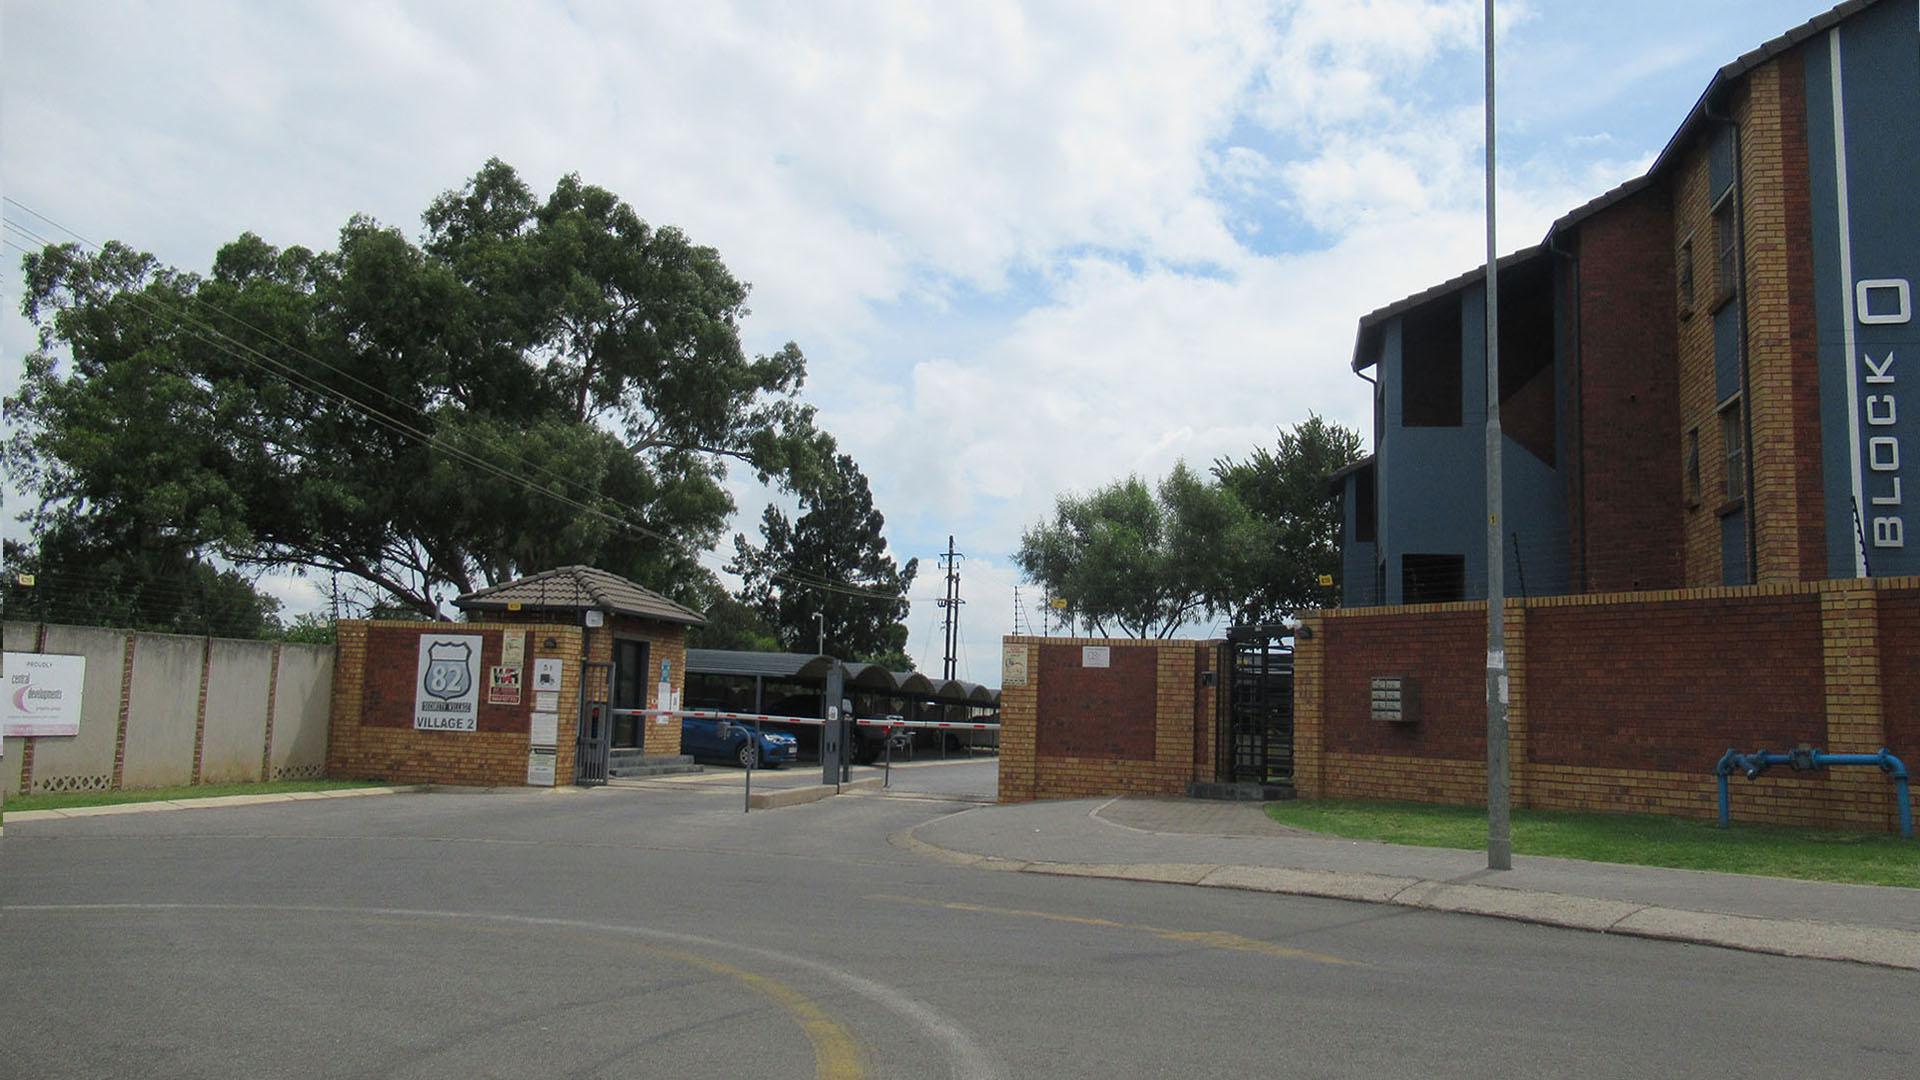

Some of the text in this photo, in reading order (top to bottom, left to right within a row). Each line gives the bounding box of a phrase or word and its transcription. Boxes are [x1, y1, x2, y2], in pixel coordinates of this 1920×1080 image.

[1856, 278, 1911, 547] BLOCK O
[11, 672, 31, 684] central
[431, 665, 464, 692] 82
[28, 687, 62, 700] developments
[423, 702, 471, 713] SECURITY VILLAGE
[417, 717, 474, 729] VILLAGE 2
